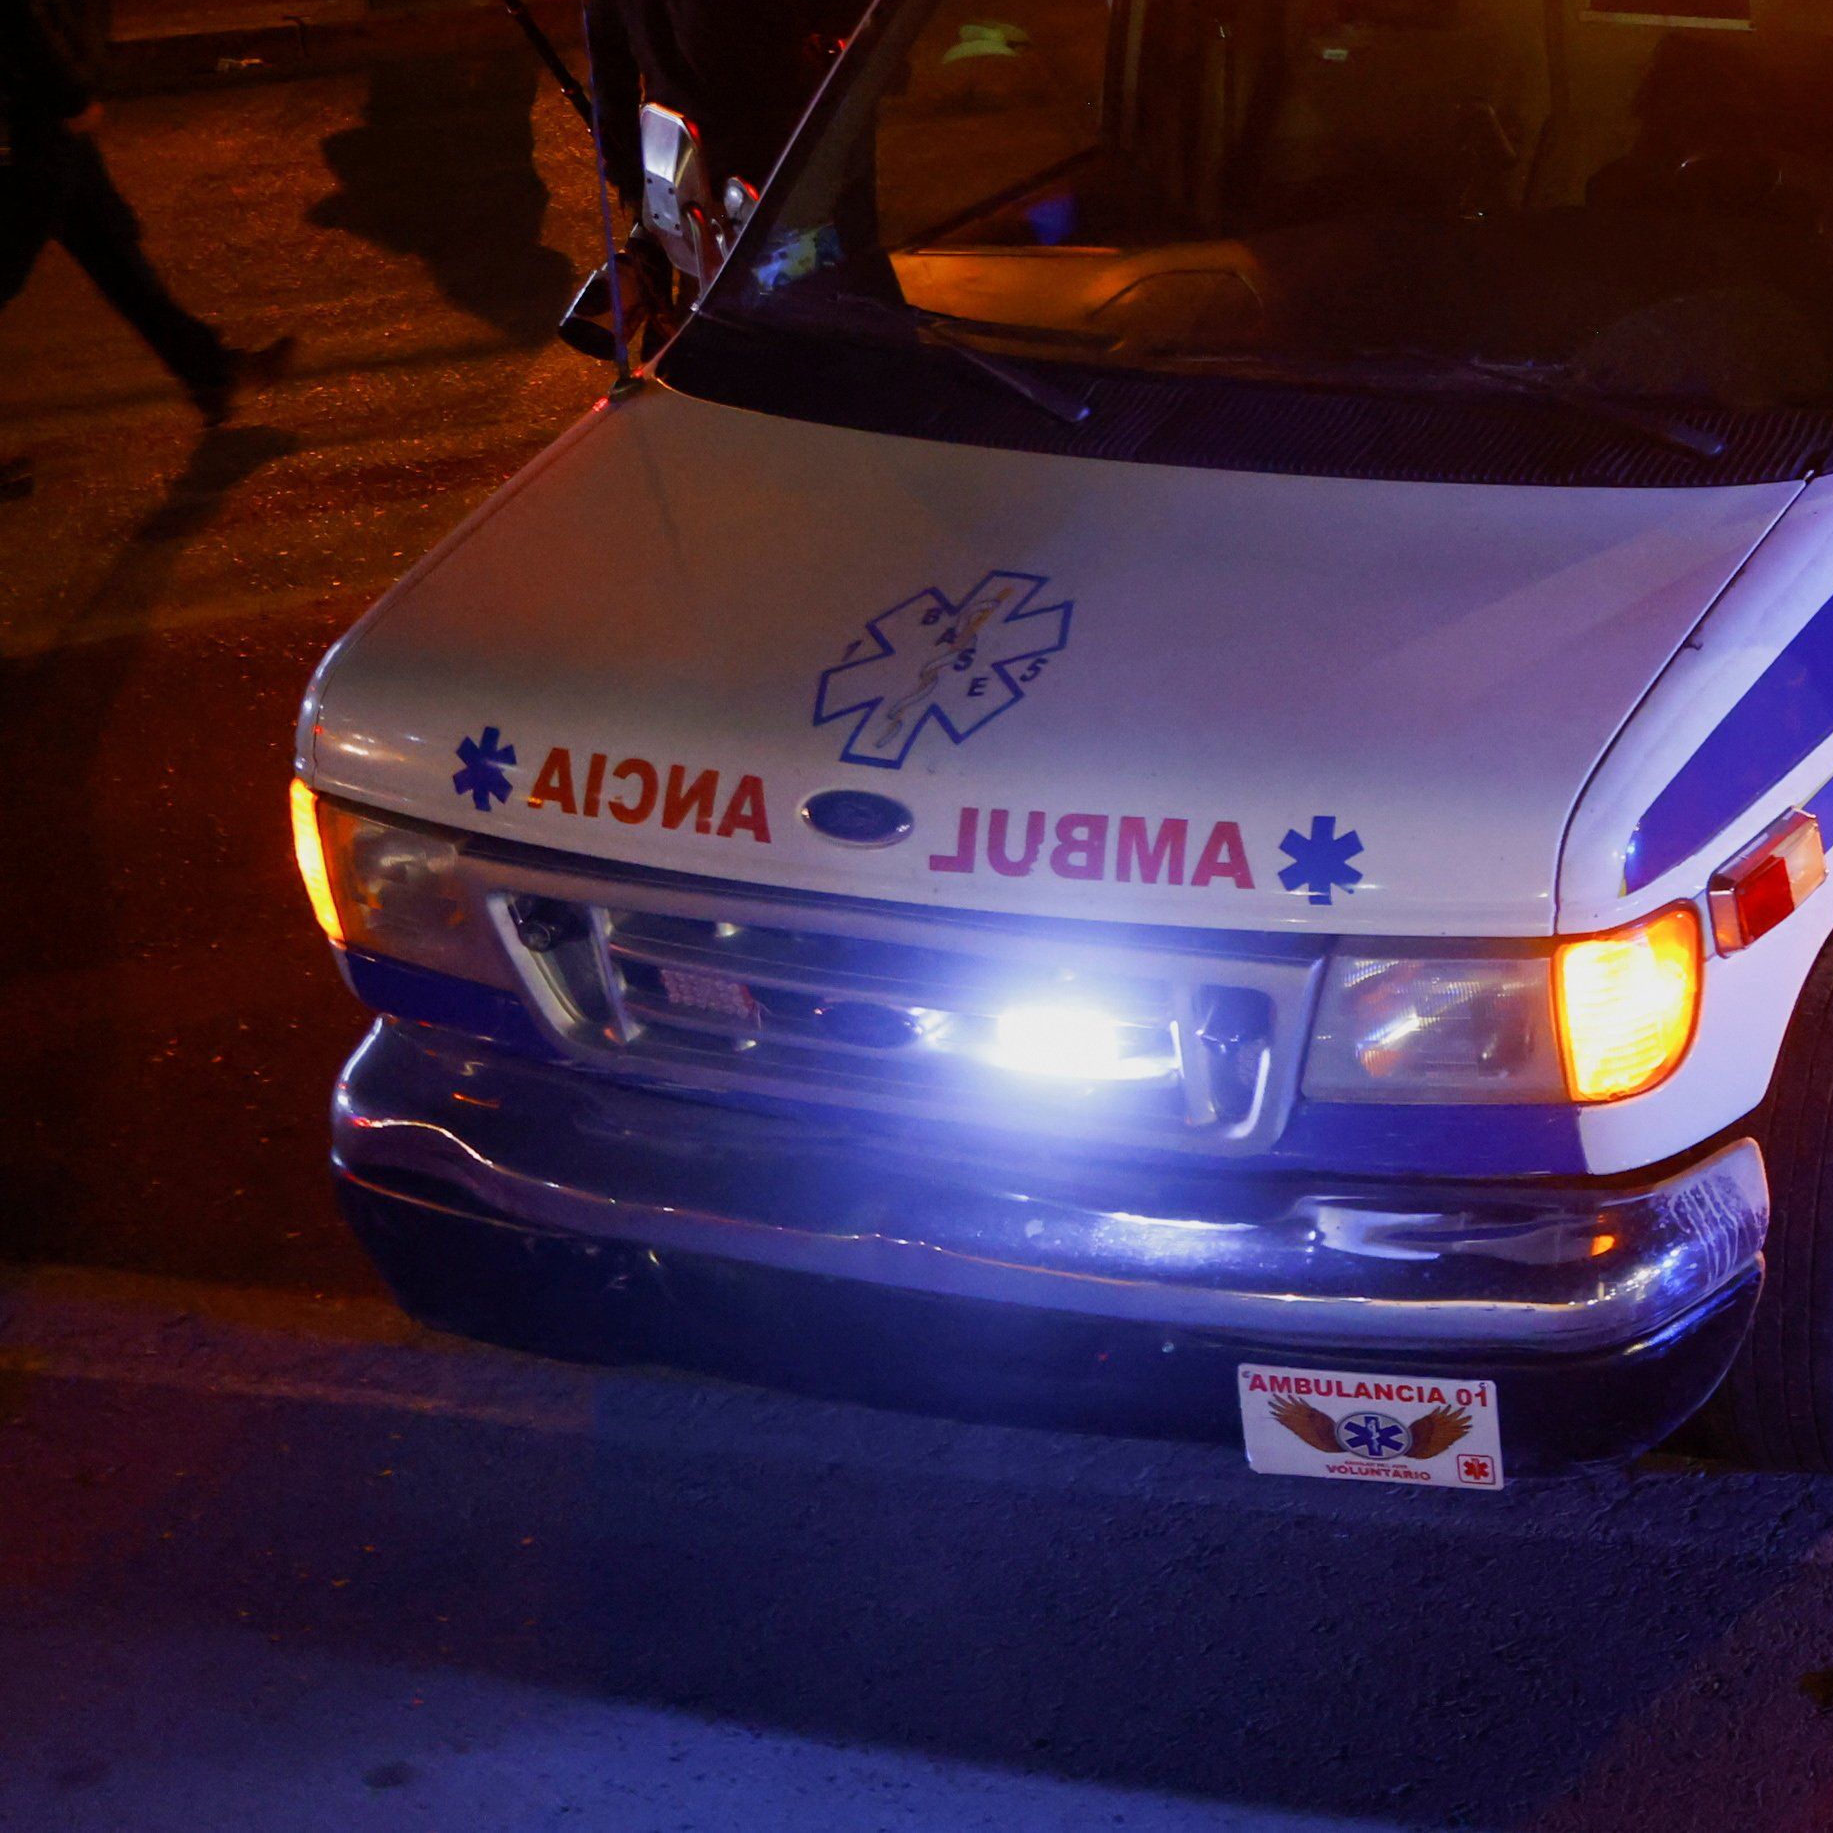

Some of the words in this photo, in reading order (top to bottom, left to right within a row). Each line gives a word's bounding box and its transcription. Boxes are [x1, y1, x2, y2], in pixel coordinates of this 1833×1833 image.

[1249, 1374, 1447, 1405] AMBULANCIA
[1456, 1387, 1488, 1407] 01
[1326, 1464, 1432, 1481] VOLUNTARIO
